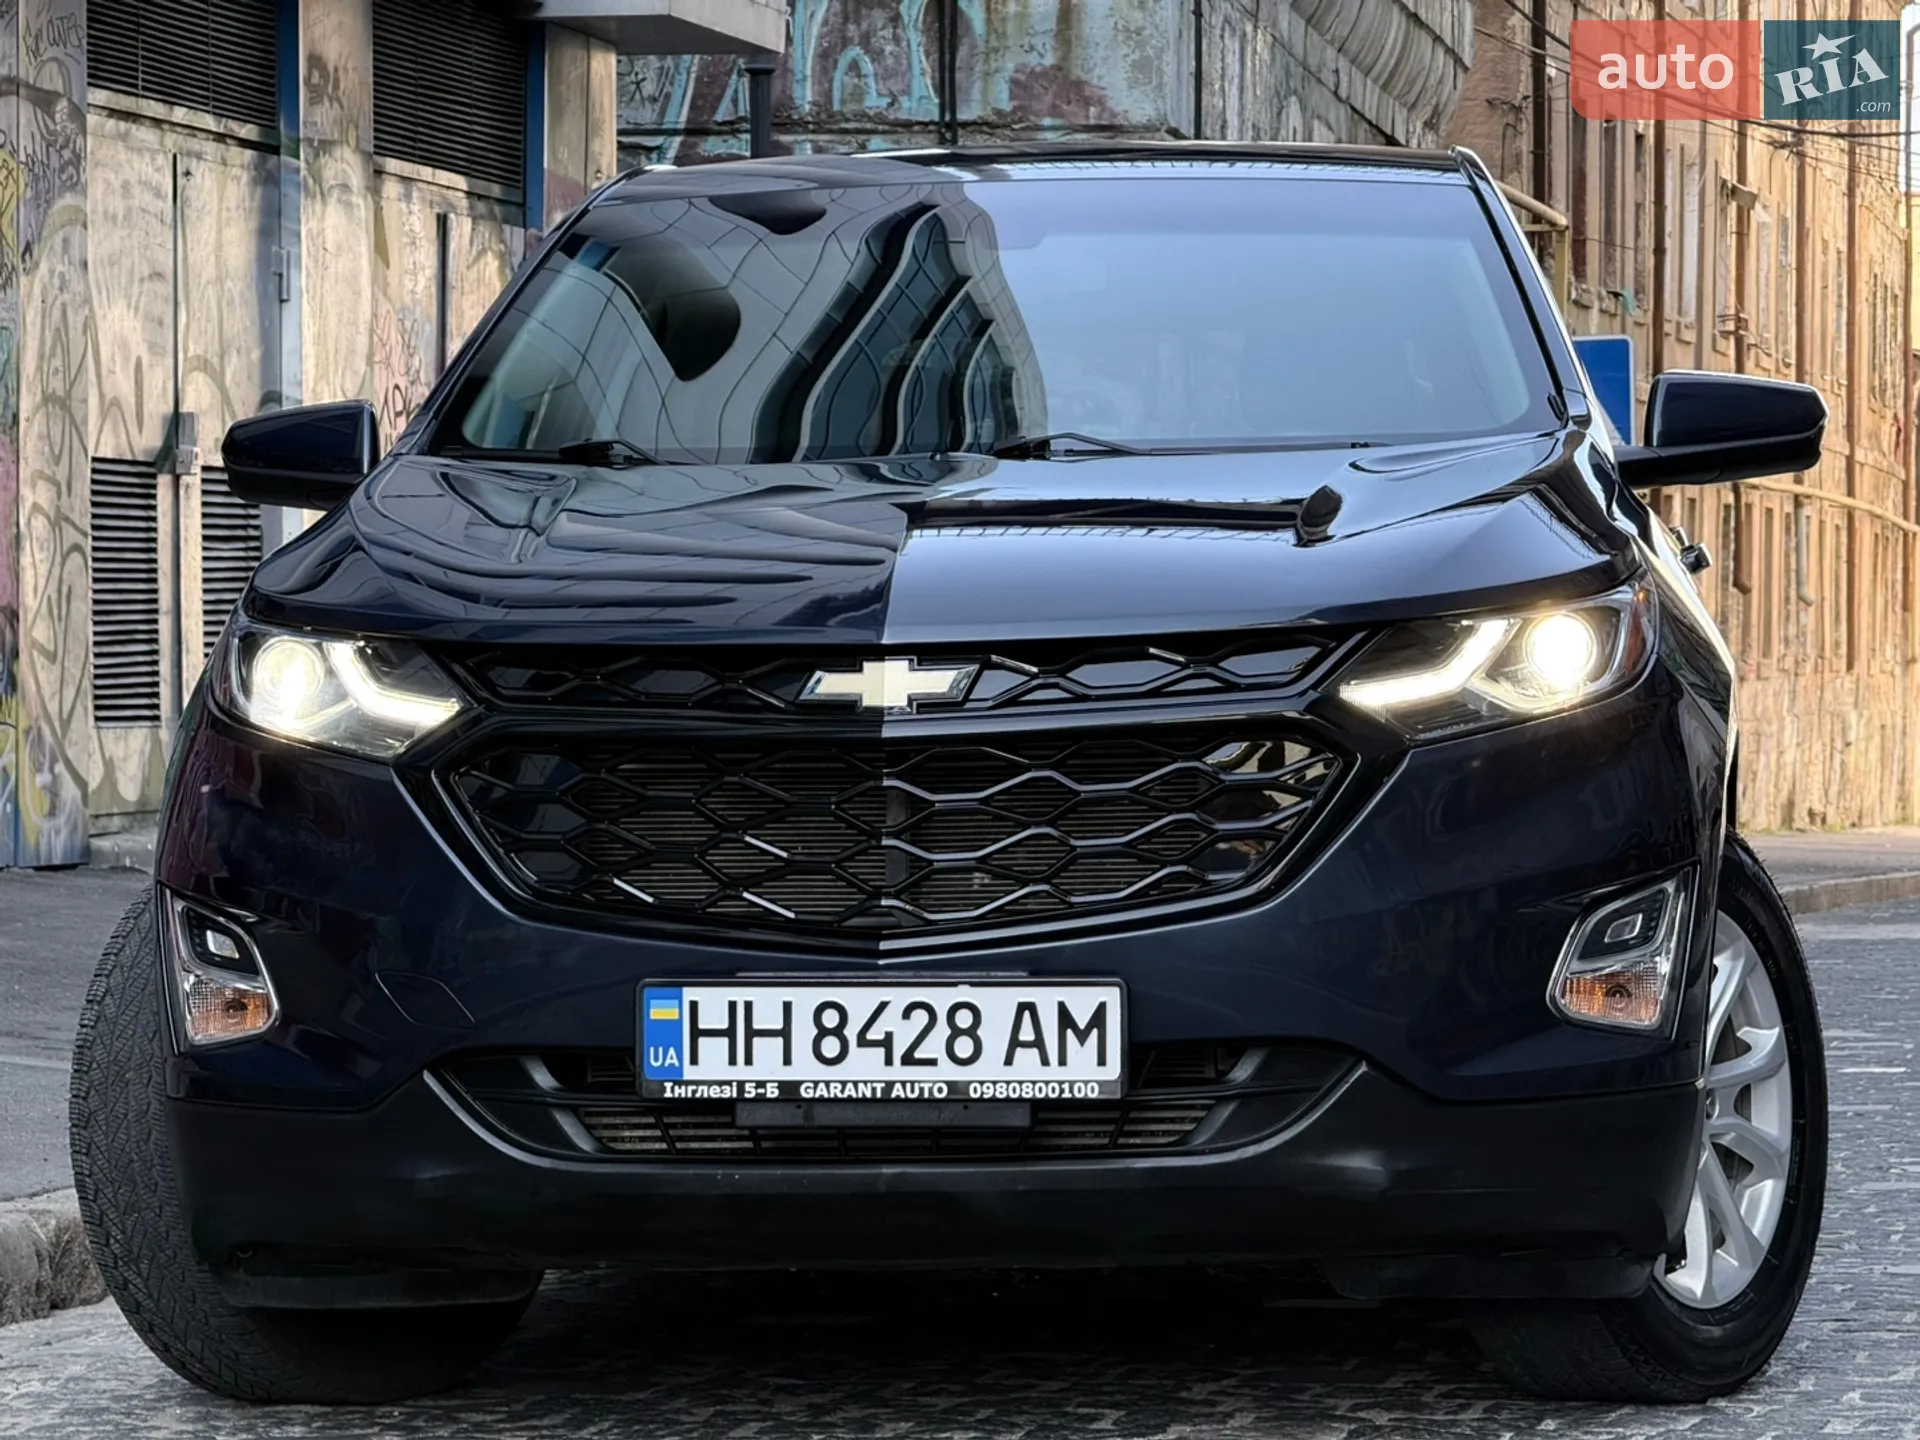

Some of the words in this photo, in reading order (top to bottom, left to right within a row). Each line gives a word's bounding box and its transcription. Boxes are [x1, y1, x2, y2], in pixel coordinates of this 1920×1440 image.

[688, 999, 793, 1067] HH
[811, 999, 983, 1067] 8428
[1003, 999, 1108, 1067] AM
[649, 1046, 680, 1068] UA
[800, 1082, 885, 1098] GARANT
[891, 1082, 948, 1098] AUTO
[969, 1082, 1099, 1098] 0980800100
